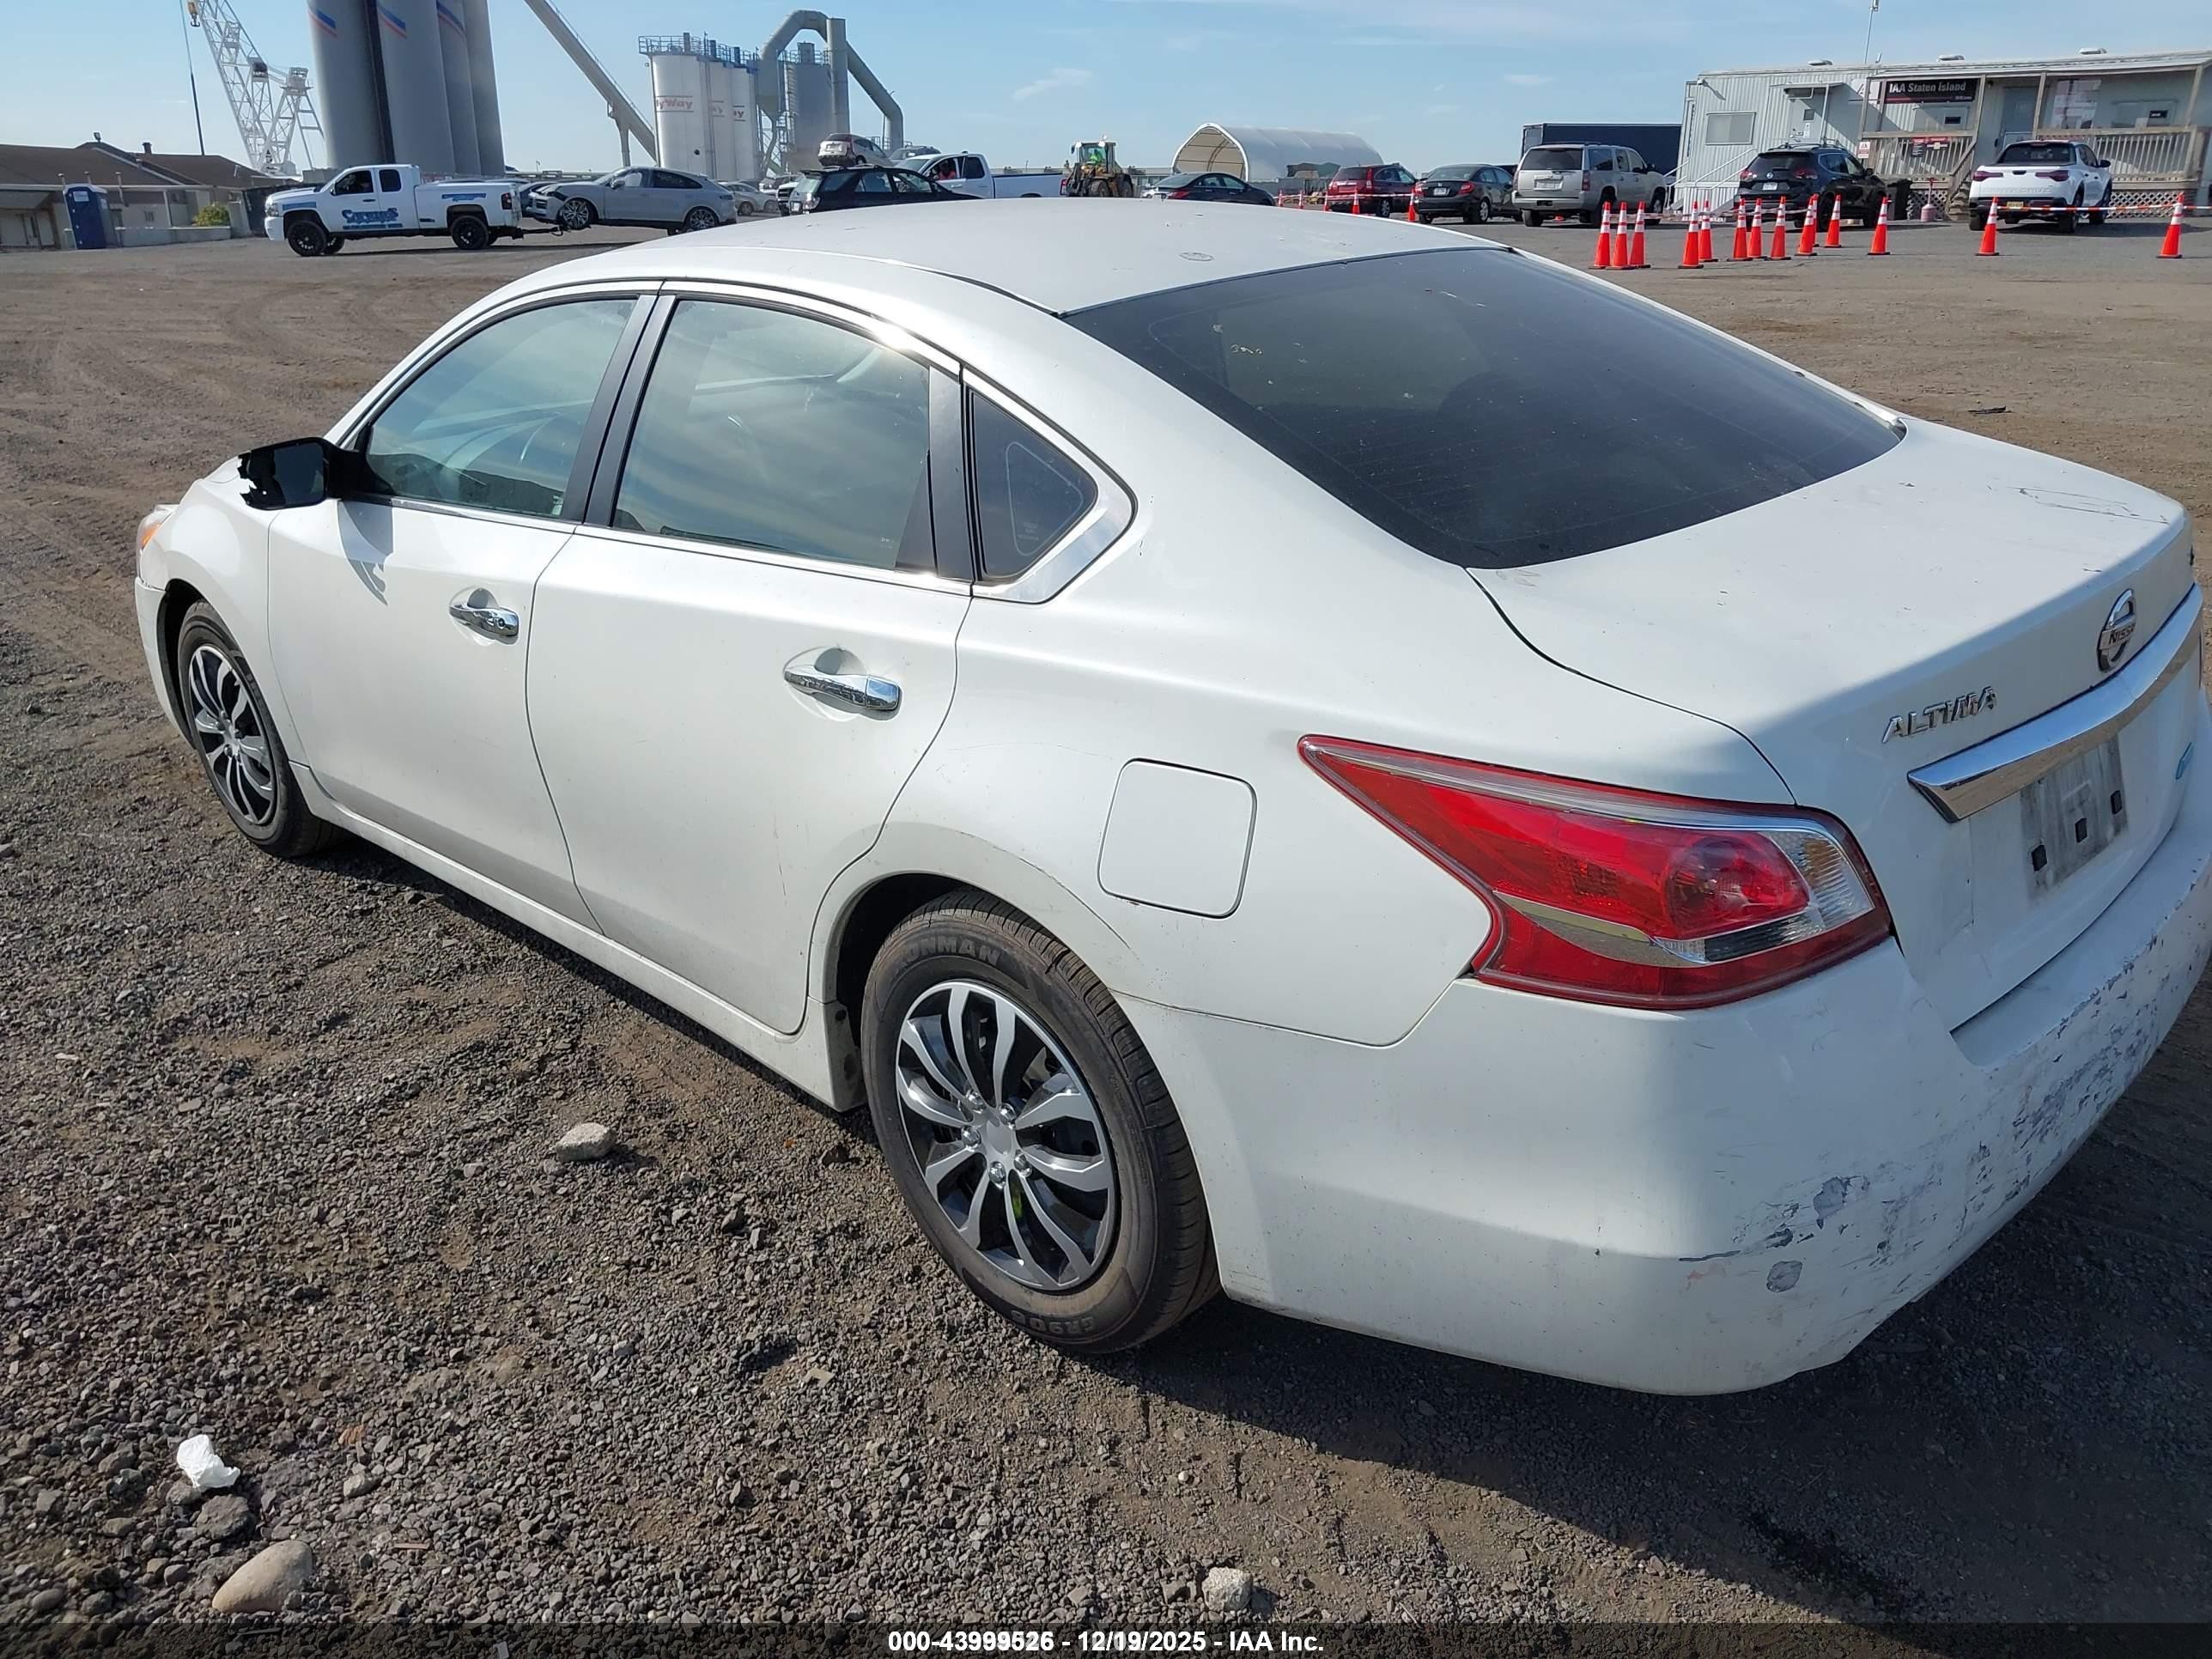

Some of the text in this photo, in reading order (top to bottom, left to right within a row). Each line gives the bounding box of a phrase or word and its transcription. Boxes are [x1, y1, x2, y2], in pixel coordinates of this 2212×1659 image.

[1889, 82, 1966, 94] IAA Staten Island
[1881, 686, 1996, 744] ALTIMA
[896, 935, 1002, 976] ONMAN
